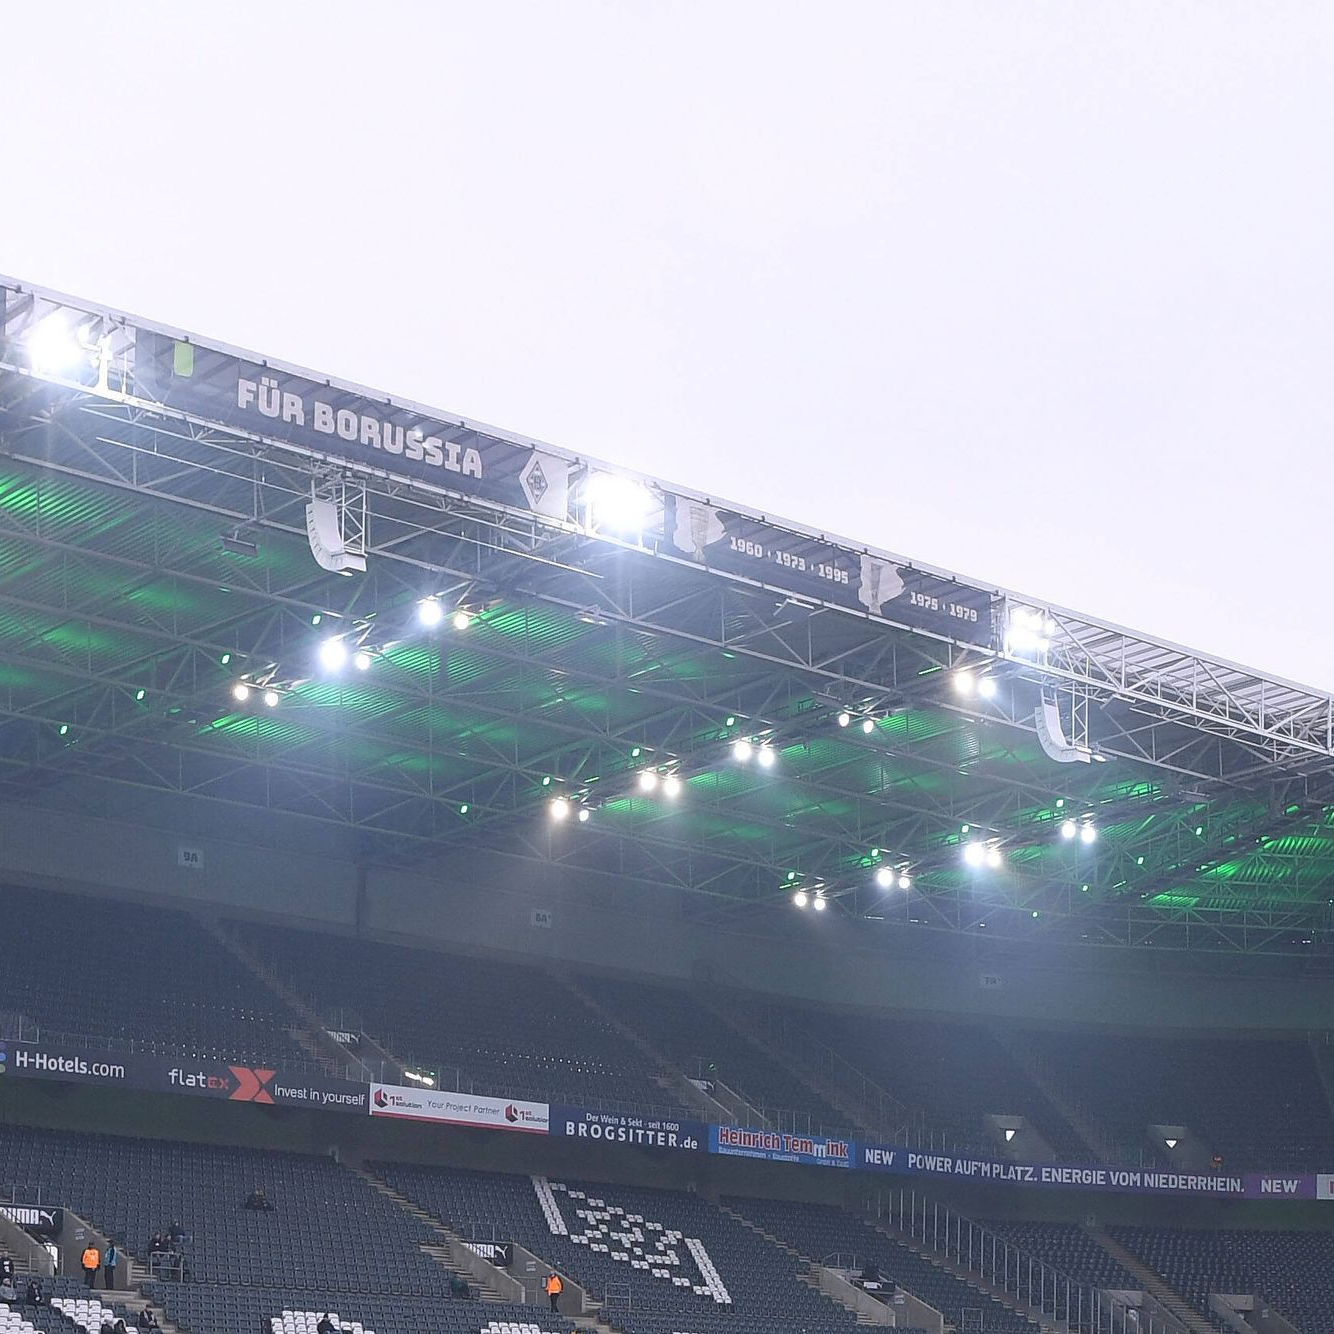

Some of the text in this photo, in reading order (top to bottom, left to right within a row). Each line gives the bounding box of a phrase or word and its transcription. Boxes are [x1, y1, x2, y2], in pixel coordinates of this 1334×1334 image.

[238, 378, 483, 480] FÜR BORUSSIA
[730, 536, 849, 584] 1960 1973 1995
[950, 602, 978, 623] 1979
[16, 1050, 125, 1079] H-Hotels.com
[274, 1084, 365, 1106] Invest in yourself
[446, 1103, 472, 1113] Project
[586, 1112, 598, 1123] Der
[600, 1113, 618, 1125] Wein
[627, 1116, 642, 1127] Sekt
[648, 1120, 660, 1130] seit
[566, 1122, 698, 1150] BROGSITTER.de
[718, 1126, 780, 1150] Heinrich
[783, 1134, 849, 1158] Temmink
[865, 1148, 893, 1166] NEW
[908, 1153, 1245, 1193] POWER AUF'M PLATZ. ENERGIE VOM NIEDERRHEIN.
[1261, 1179, 1298, 1193] NEW
